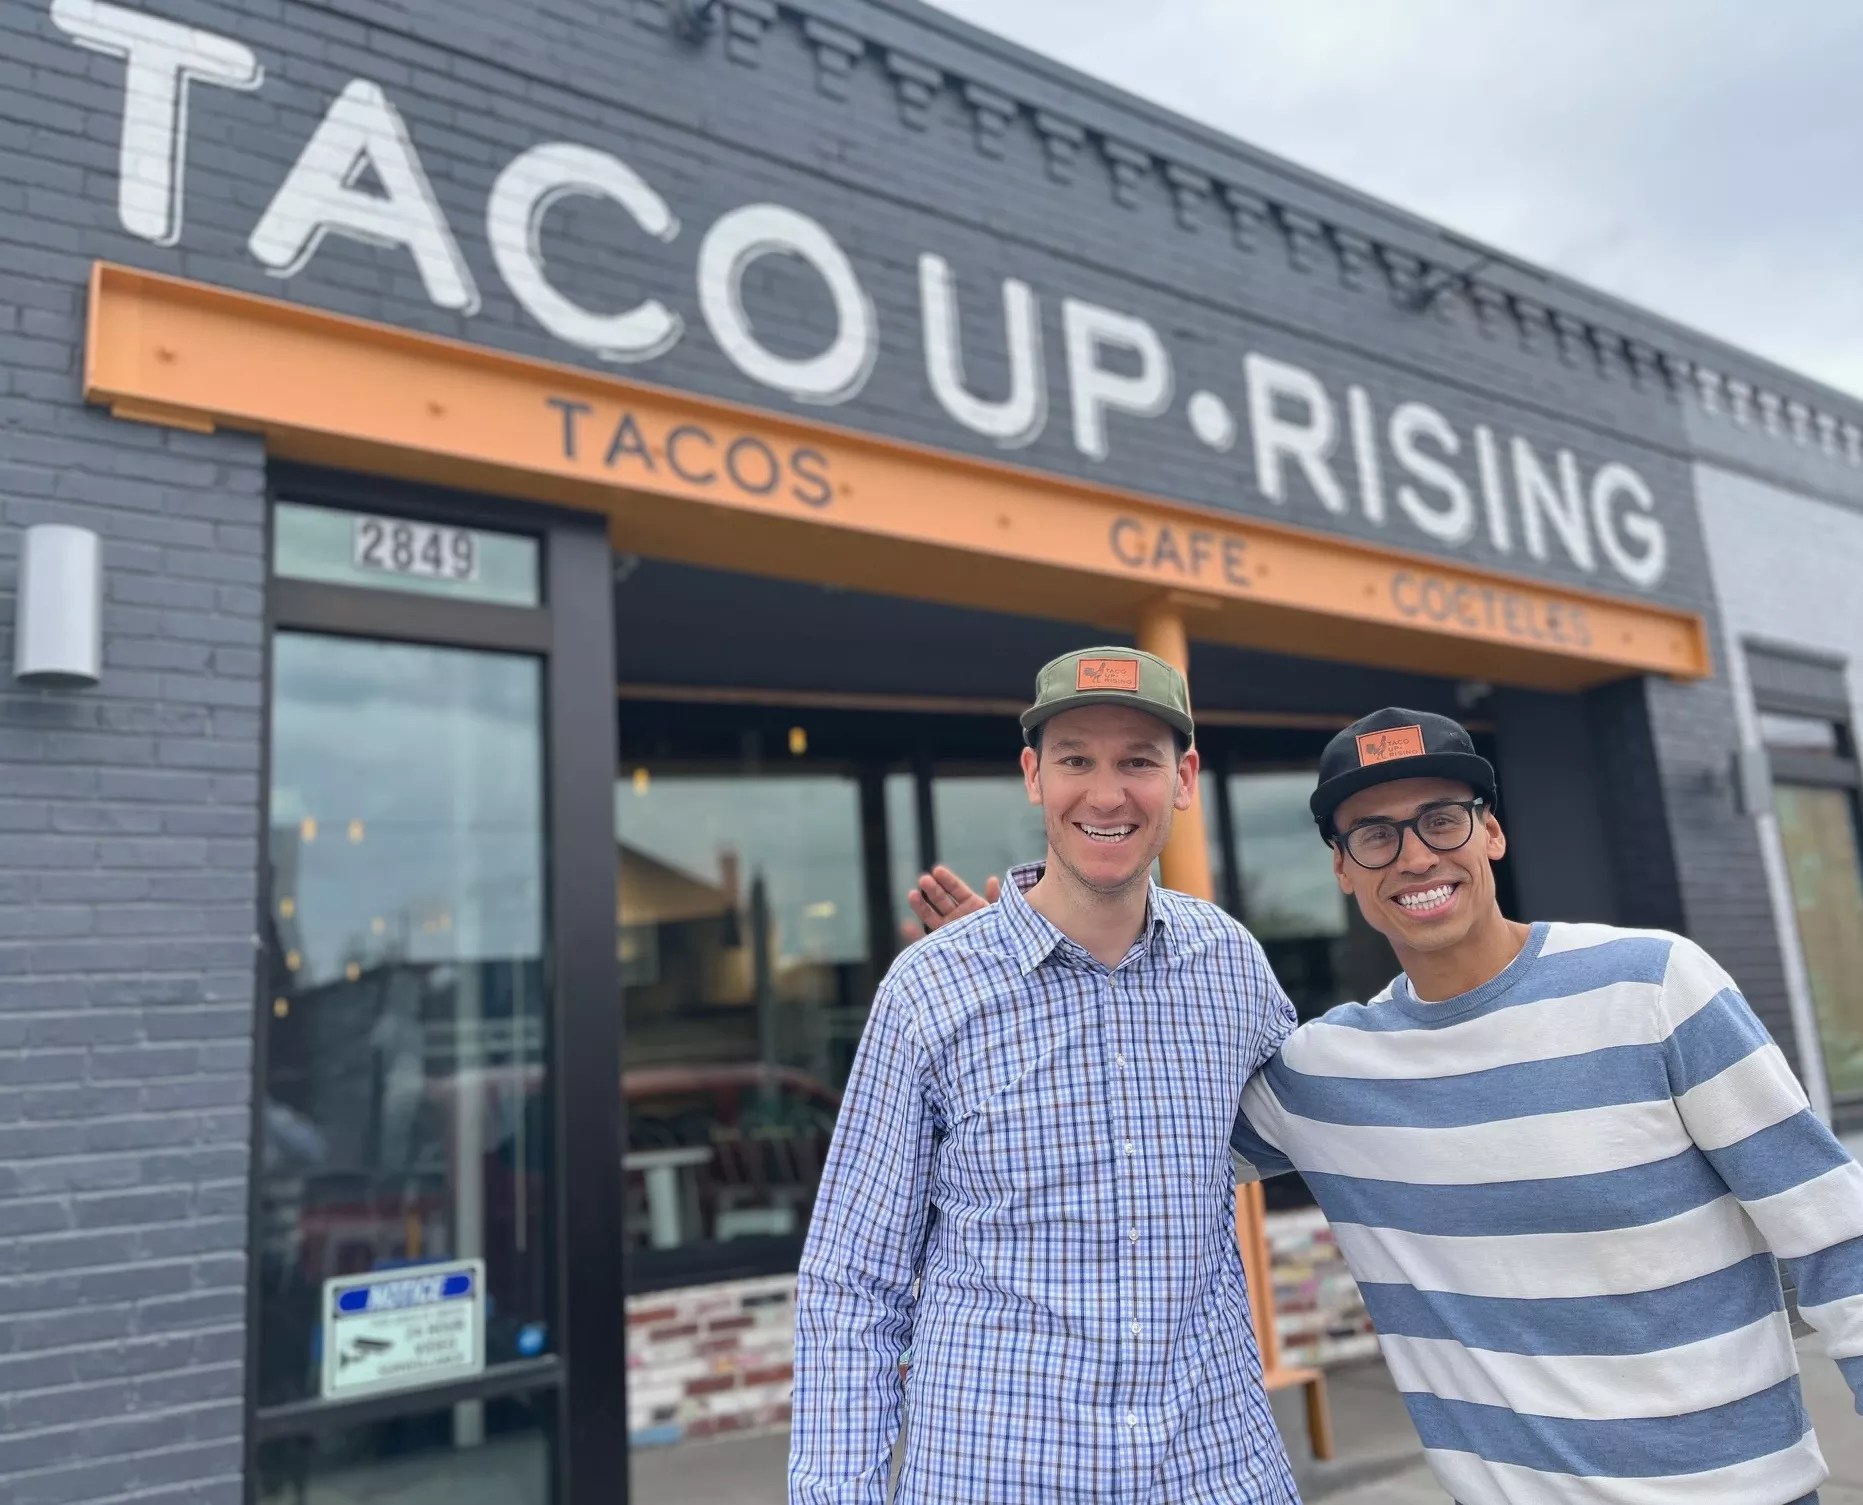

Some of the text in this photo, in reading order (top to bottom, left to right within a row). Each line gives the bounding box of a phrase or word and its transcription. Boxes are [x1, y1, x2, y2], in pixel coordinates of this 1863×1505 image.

[48, 0, 878, 405] TACO
[361, 516, 475, 580] 2849
[545, 396, 1593, 648] TACOS CAFE COCTELES
[1387, 738, 1409, 746] TACO
[1389, 749, 1418, 757] RISING
